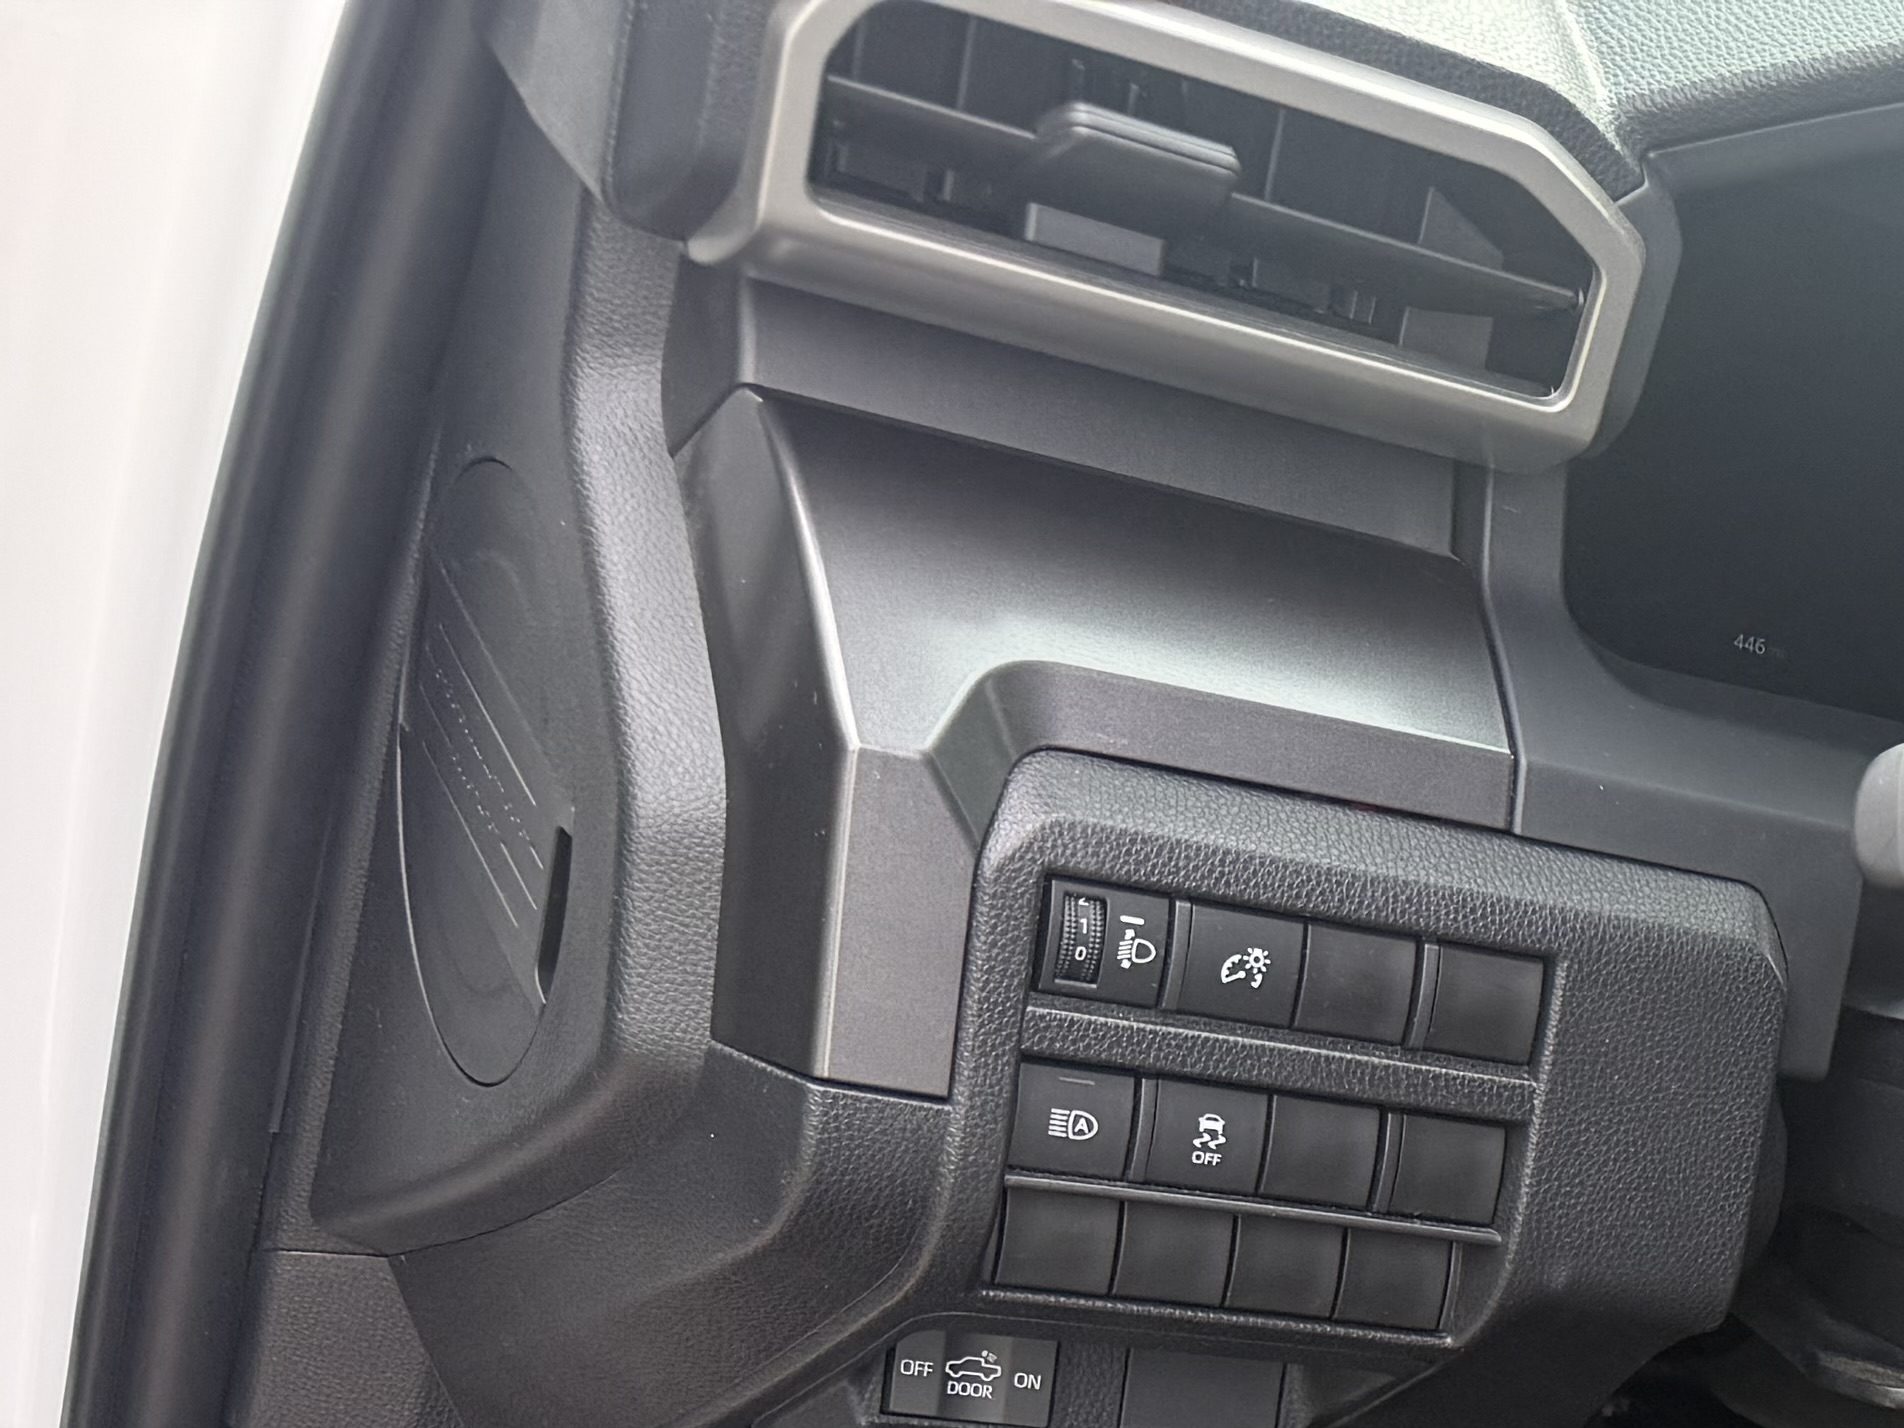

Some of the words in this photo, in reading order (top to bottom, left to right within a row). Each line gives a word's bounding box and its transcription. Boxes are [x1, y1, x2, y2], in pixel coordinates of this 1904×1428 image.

[1080, 917, 1088, 934] 1
[1075, 946, 1087, 961] 0
[1191, 1151, 1222, 1166] OFF
[900, 1359, 934, 1377] OFF
[1014, 1372, 1042, 1391] ON
[946, 1380, 993, 1399] DOOR
